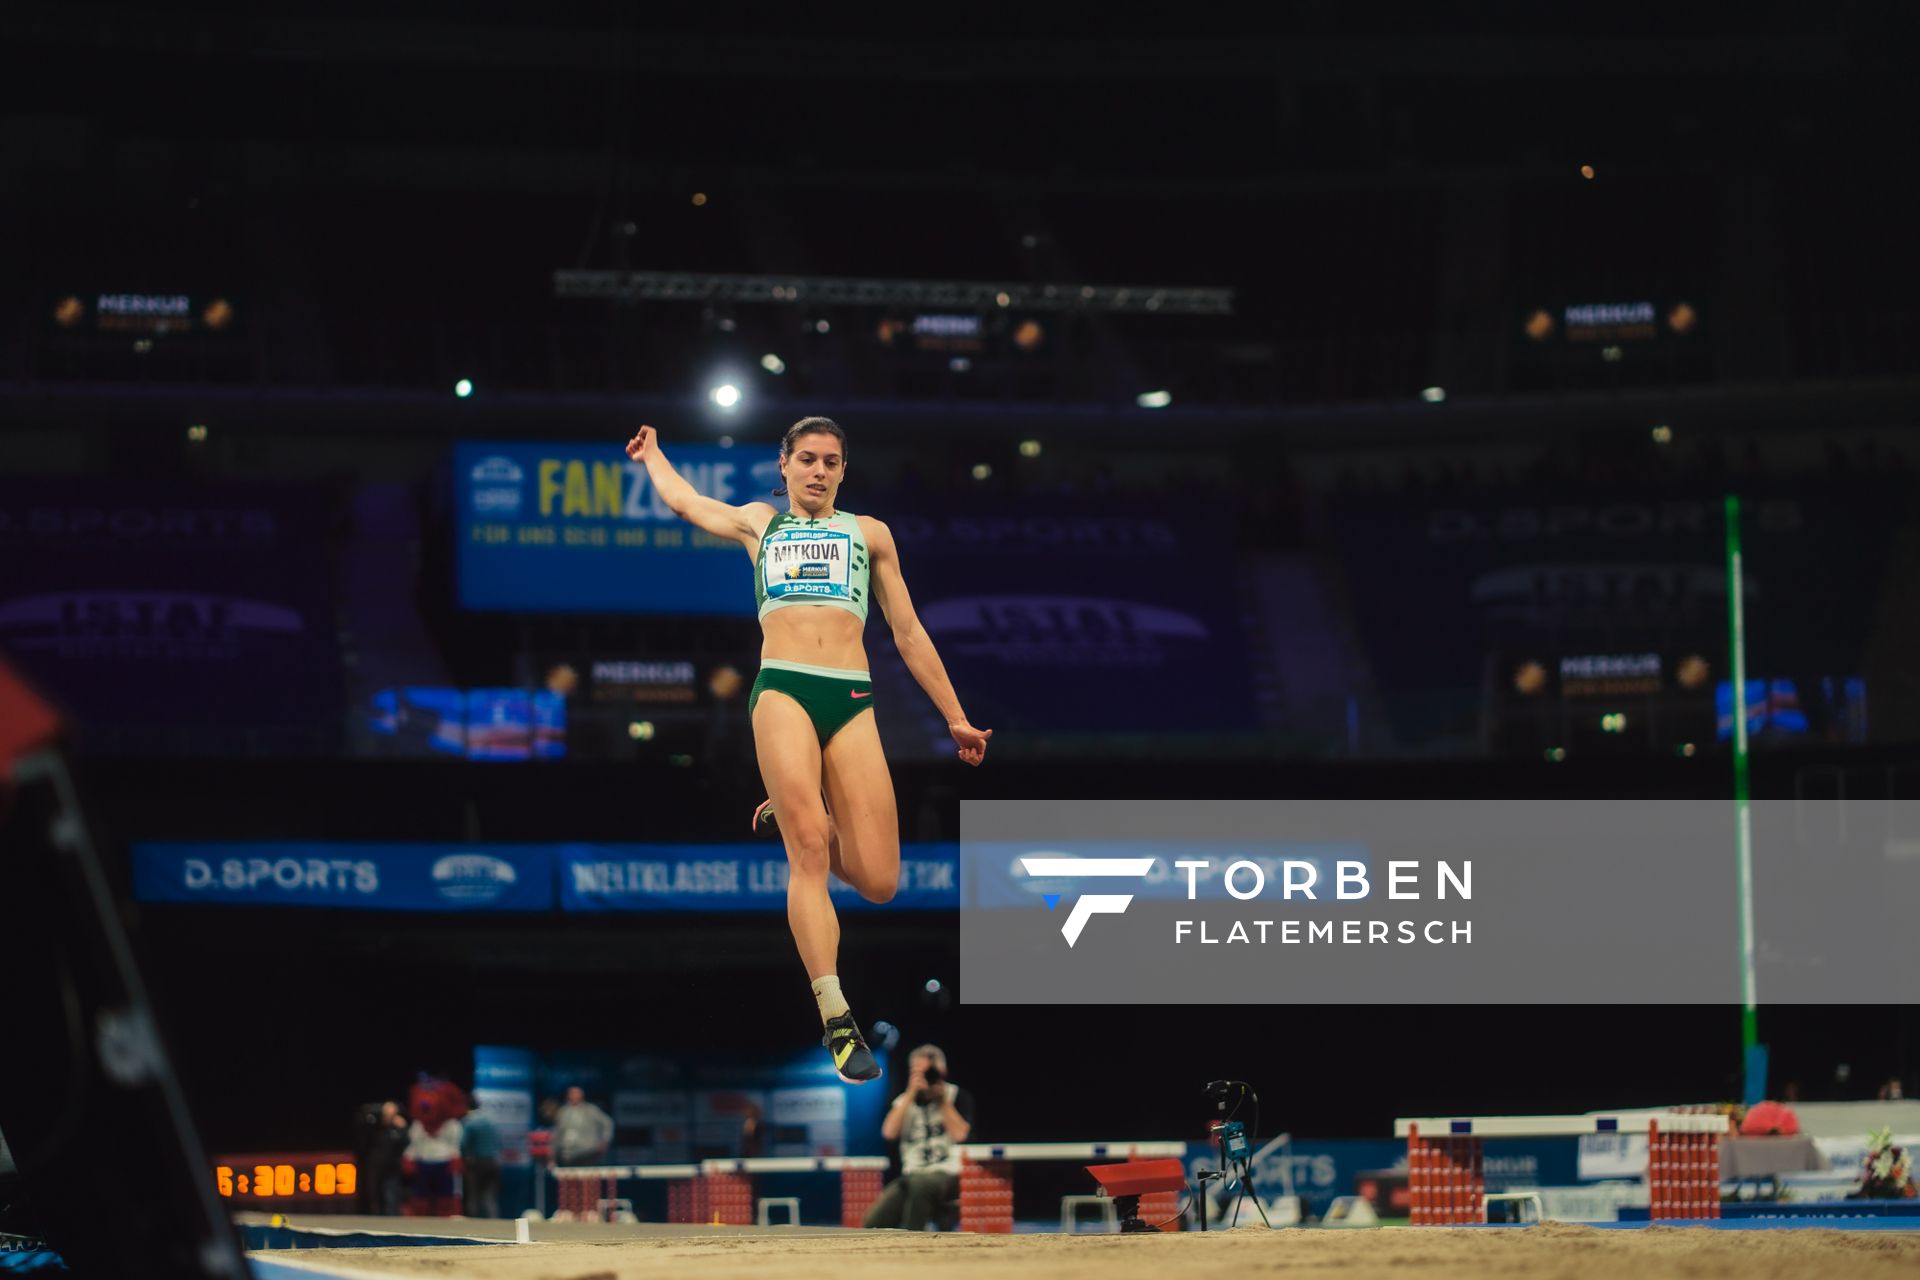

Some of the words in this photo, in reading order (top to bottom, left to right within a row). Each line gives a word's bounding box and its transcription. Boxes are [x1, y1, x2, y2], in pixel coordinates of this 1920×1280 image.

[775, 544, 840, 562] MITKOVA
[784, 584, 831, 593] D.SPORTS
[183, 857, 380, 895] D.SPORTS
[570, 860, 741, 895] WELTKLASSE
